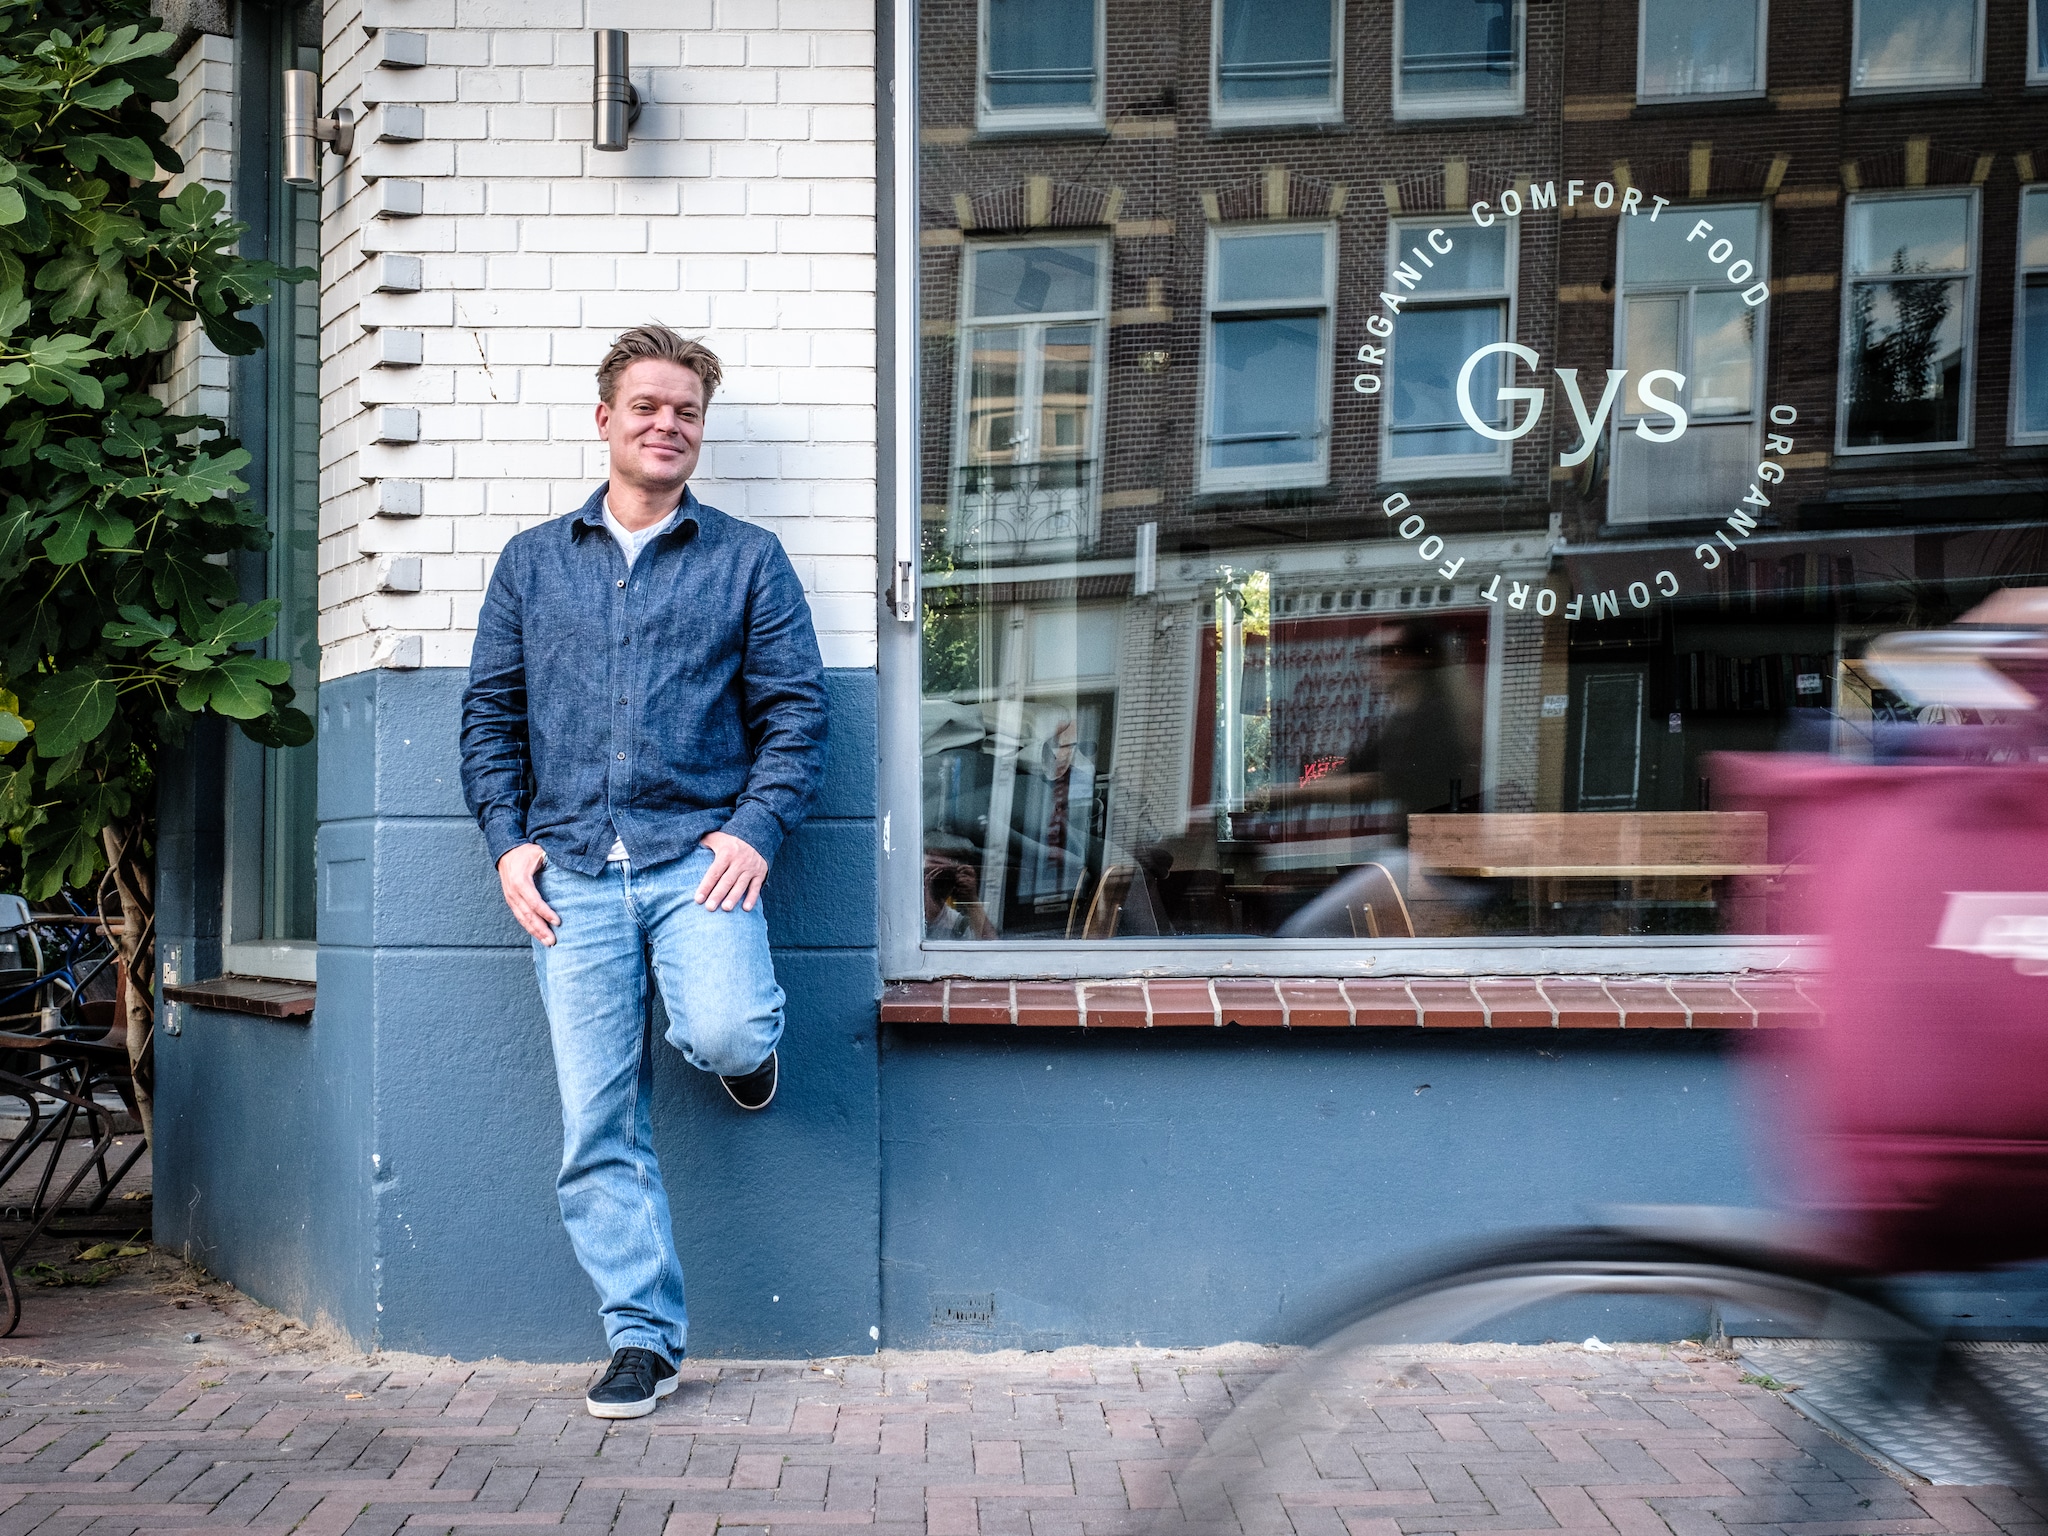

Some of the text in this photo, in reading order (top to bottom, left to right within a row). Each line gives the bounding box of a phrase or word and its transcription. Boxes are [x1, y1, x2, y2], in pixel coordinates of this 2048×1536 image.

[1353, 179, 1770, 394] ORGANIC COMFORT FOOD
[1382, 404, 1798, 620] ORGANIC COMFORT FOOD
[1456, 342, 1688, 467] Gys
